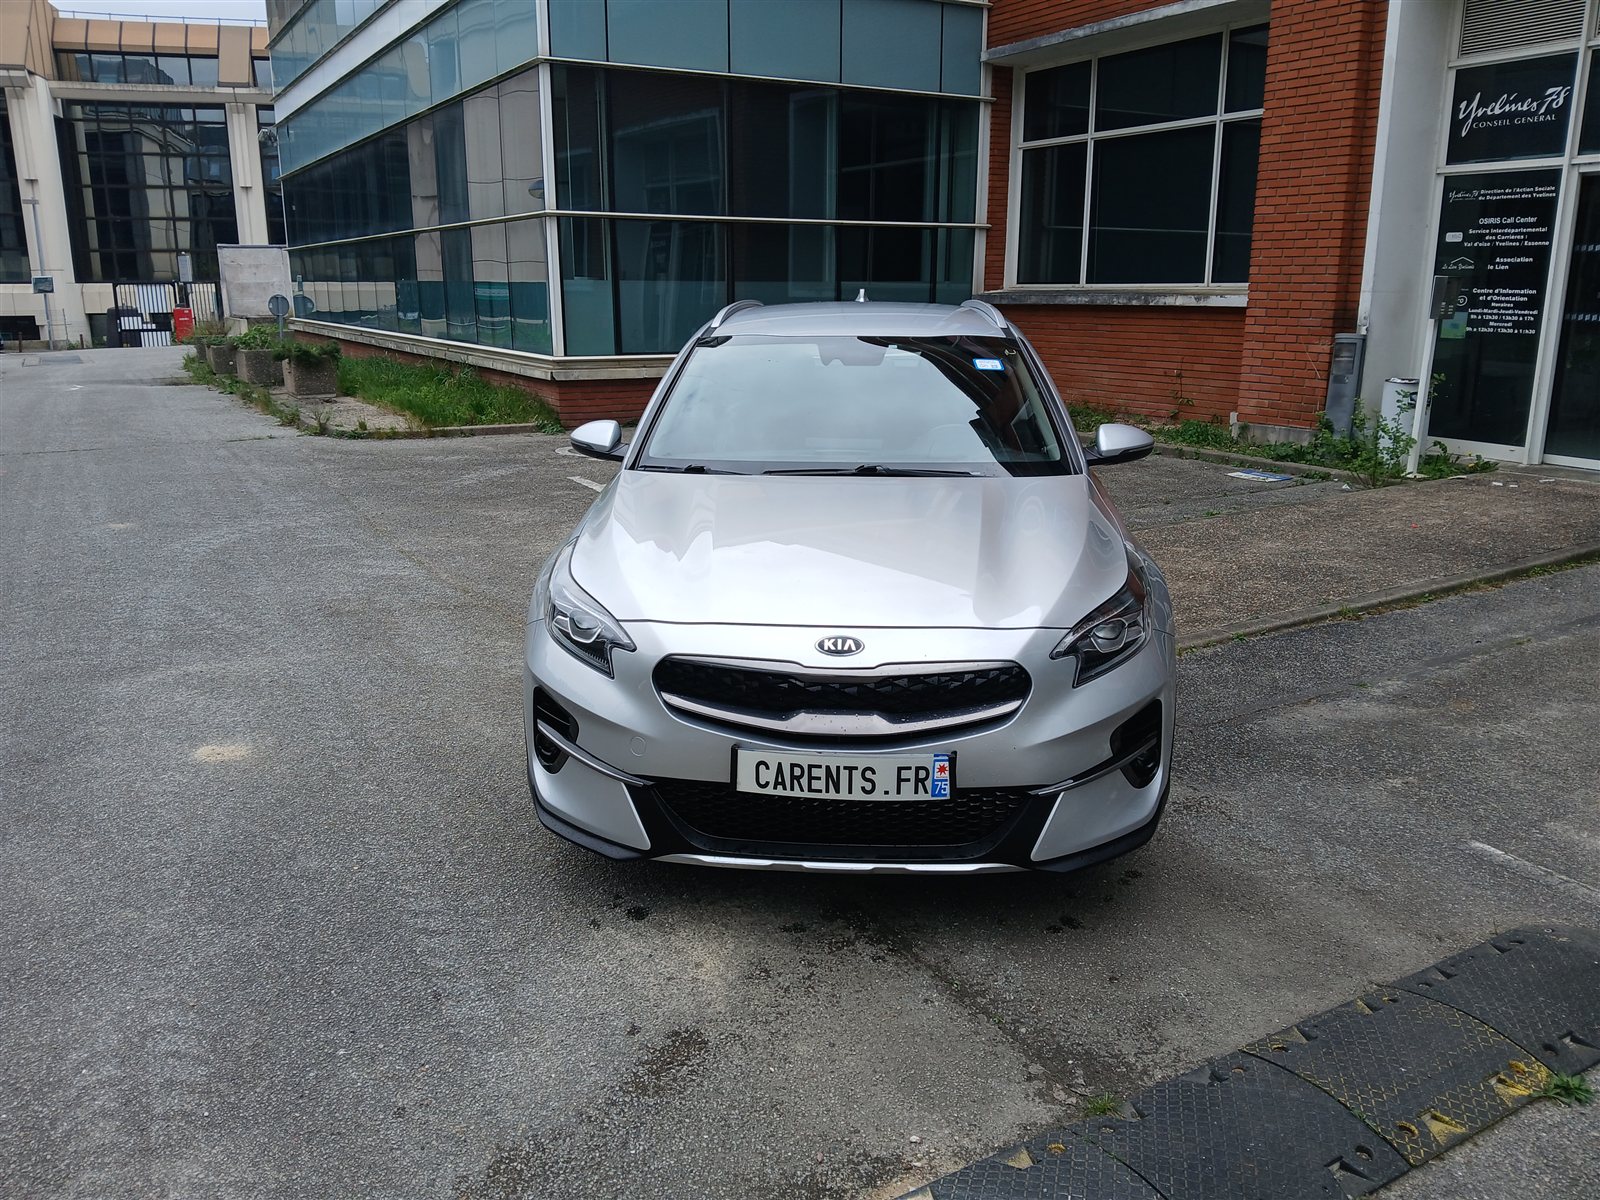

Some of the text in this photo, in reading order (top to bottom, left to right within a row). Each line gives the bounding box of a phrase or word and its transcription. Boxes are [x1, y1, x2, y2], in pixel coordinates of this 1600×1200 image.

[1459, 86, 1571, 137] Yvelines 78
[1473, 114, 1556, 129] CONSEIL GENERAL
[1478, 217, 1501, 225] OSIRIS
[822, 638, 857, 650] KIA
[755, 760, 930, 796] CARENTS.FR
[934, 781, 949, 794] 75
